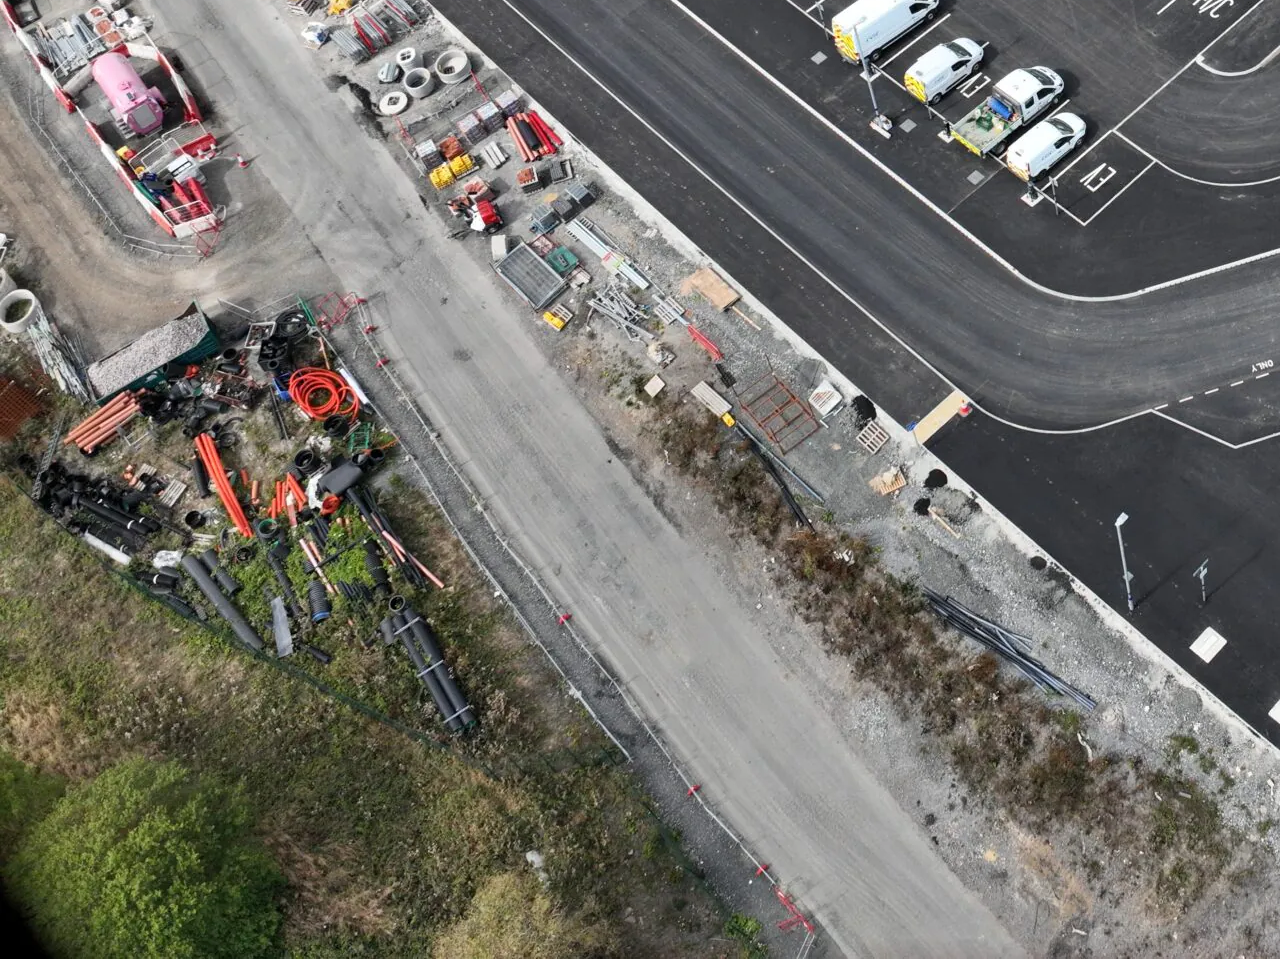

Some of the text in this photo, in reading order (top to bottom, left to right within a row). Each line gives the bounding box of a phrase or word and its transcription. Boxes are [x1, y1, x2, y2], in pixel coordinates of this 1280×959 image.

[956, 71, 992, 99] EV
[1079, 161, 1118, 194] EV
[1251, 359, 1274, 373] ONLY
